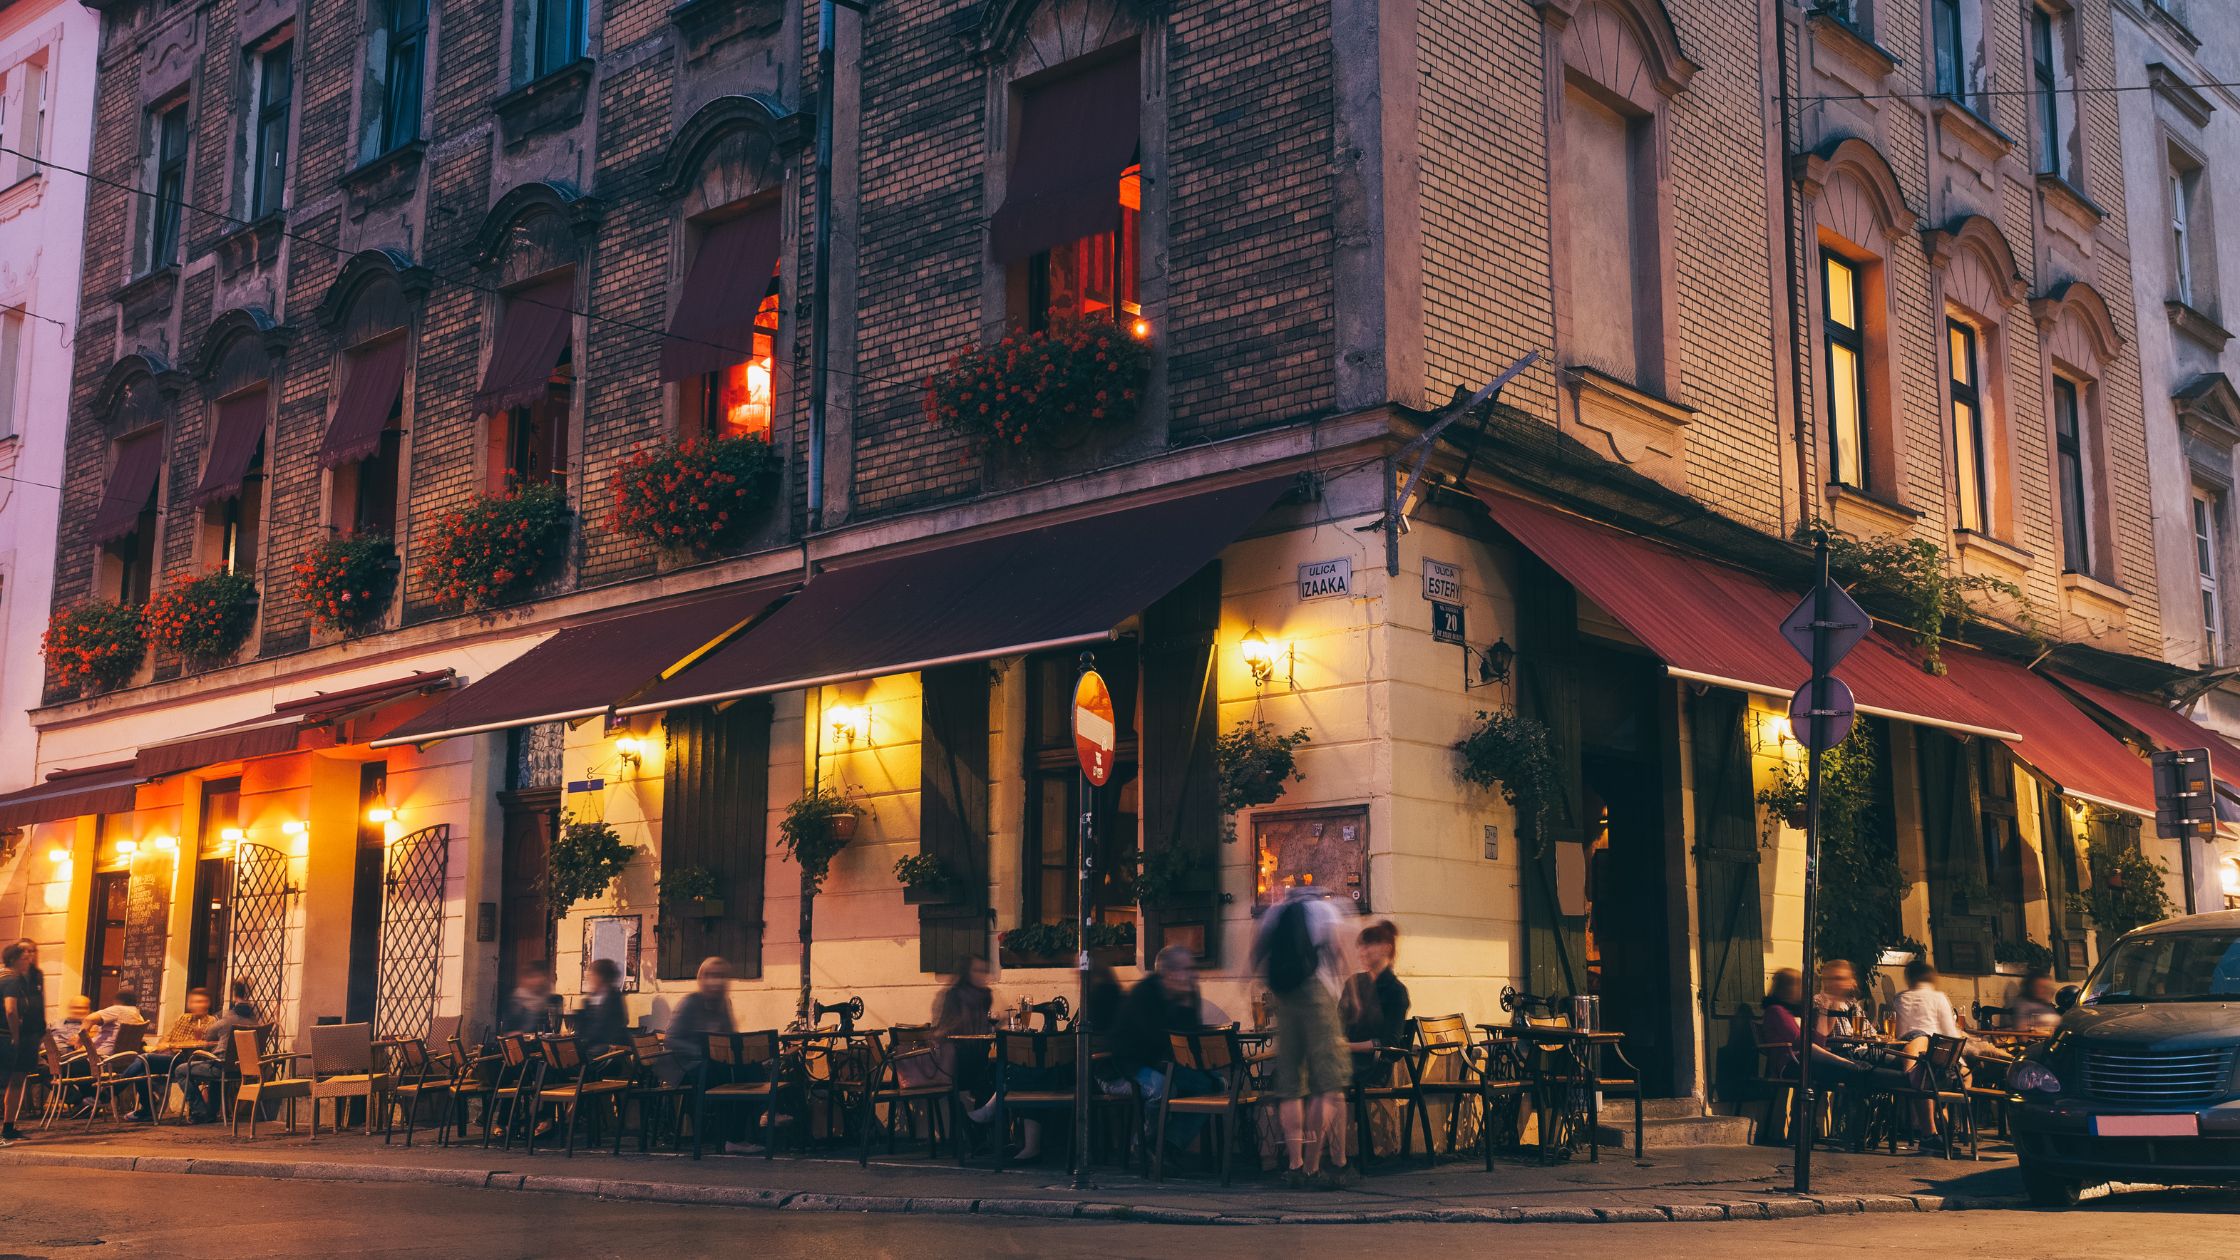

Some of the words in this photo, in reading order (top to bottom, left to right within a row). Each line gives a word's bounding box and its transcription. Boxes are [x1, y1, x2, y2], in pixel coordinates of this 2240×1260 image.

[1309, 564, 1336, 576] ULICA
[1434, 565, 1455, 578] ULICA
[1301, 576, 1346, 598] IZAAKA
[1428, 577, 1460, 599] ESTERY
[1445, 612, 1458, 632] 20
